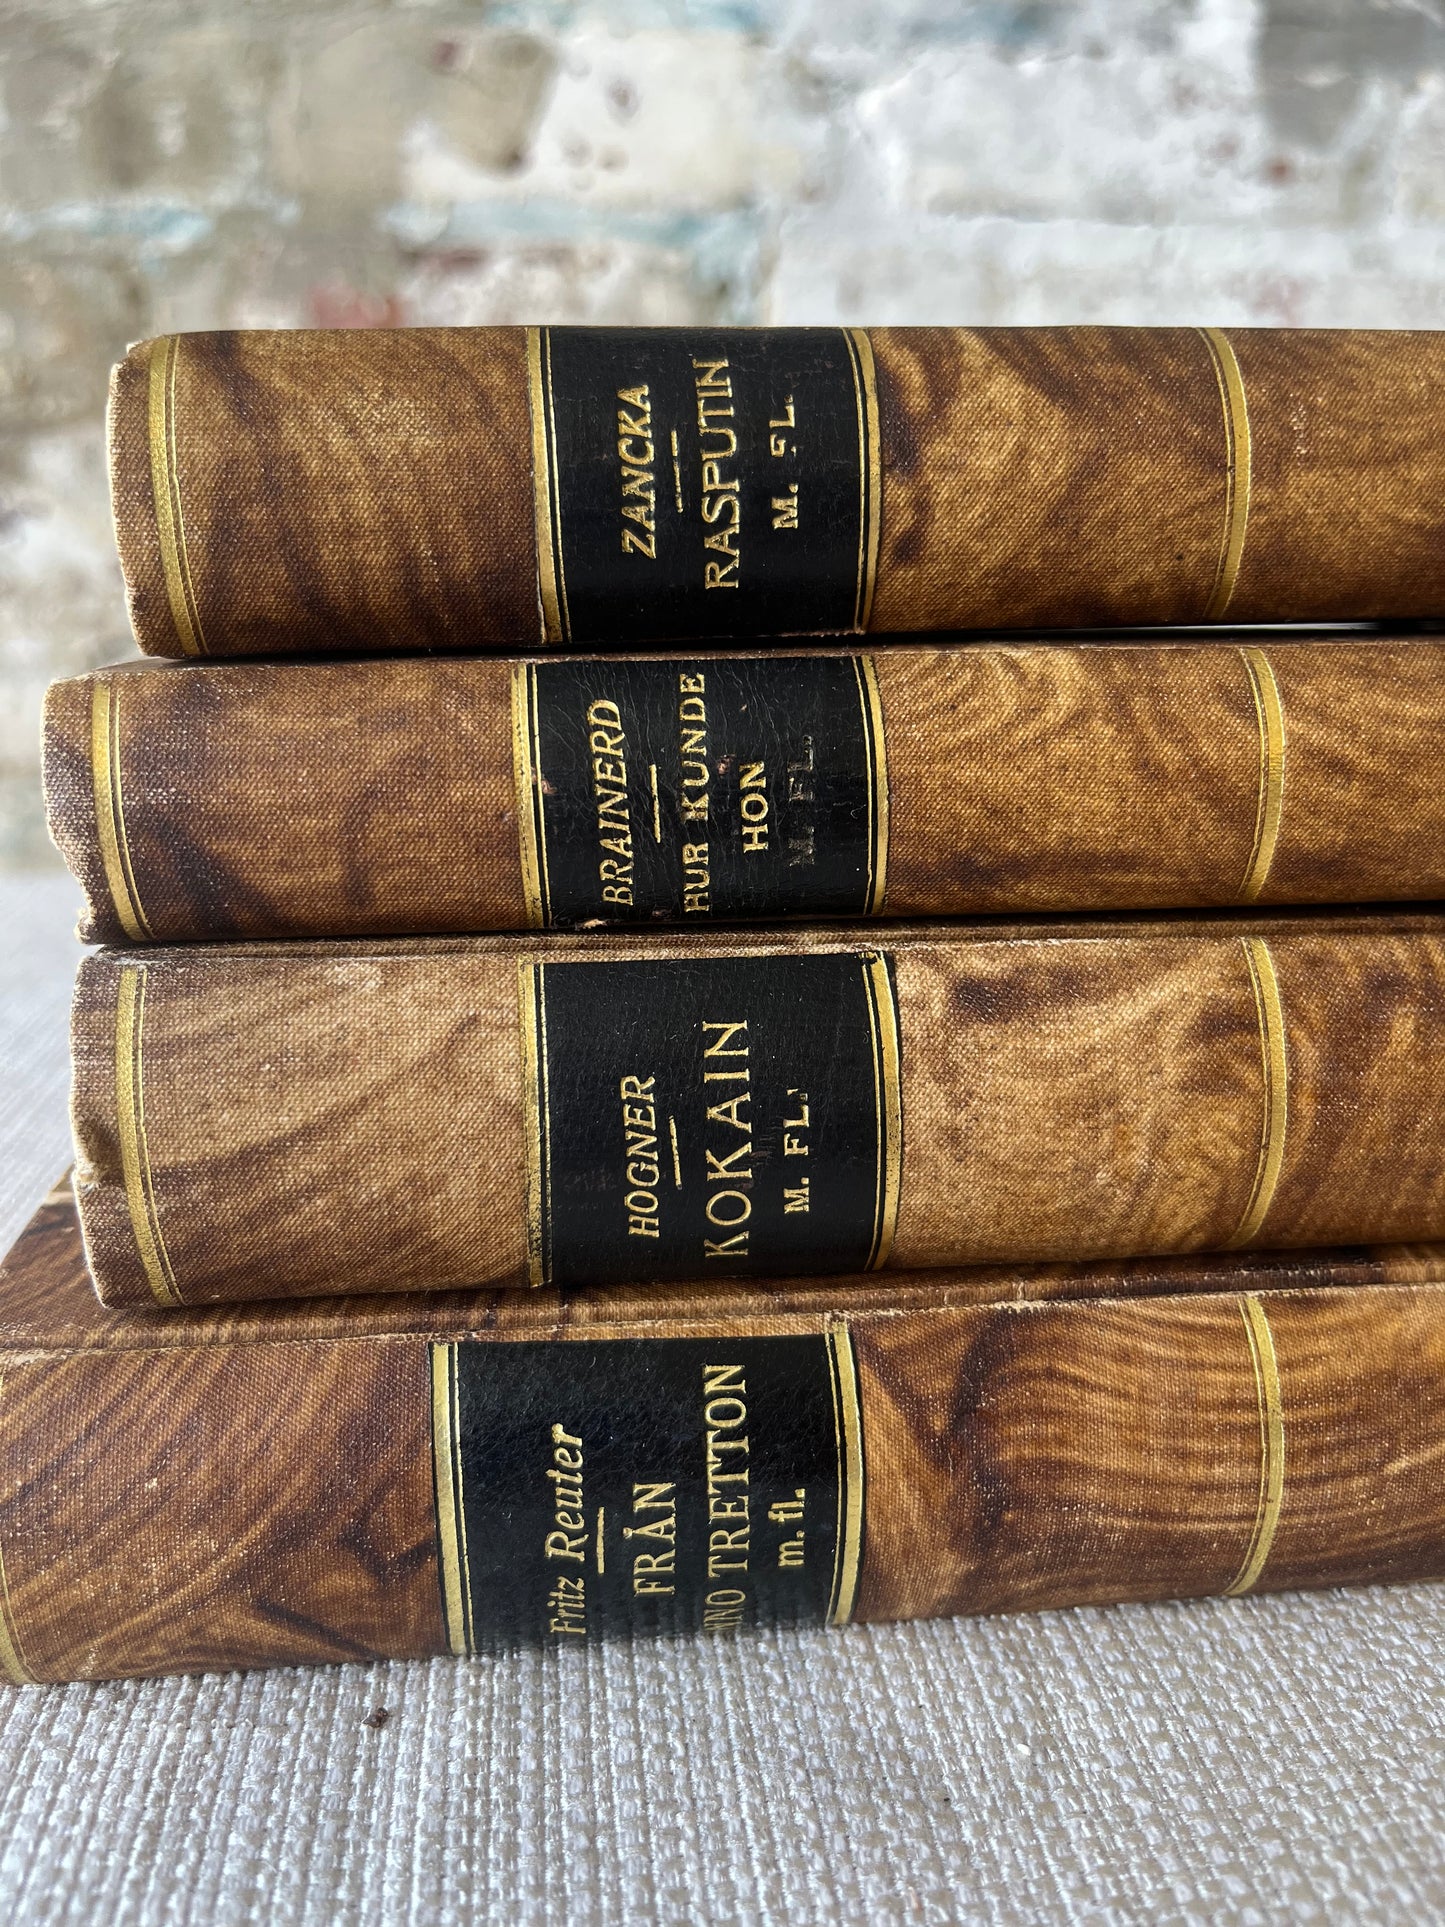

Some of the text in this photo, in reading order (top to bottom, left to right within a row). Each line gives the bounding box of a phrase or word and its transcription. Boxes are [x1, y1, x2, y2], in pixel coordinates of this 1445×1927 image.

[617, 384, 656, 559] ZANCKA
[692, 358, 740, 590] RASPUTIN
[771, 483, 798, 529] M.
[587, 699, 634, 906] BRAINERD
[679, 673, 710, 913] HUR KUNDE
[739, 760, 769, 853] HON
[702, 1020, 752, 1258] KOKAIN
[783, 1177, 809, 1214] M.
[545, 1423, 589, 1635] Fritz Reuter
[623, 1482, 676, 1597] FRÅN
[703, 1364, 749, 1632] NNO TRETTON
[768, 1488, 805, 1568] m. fl.
